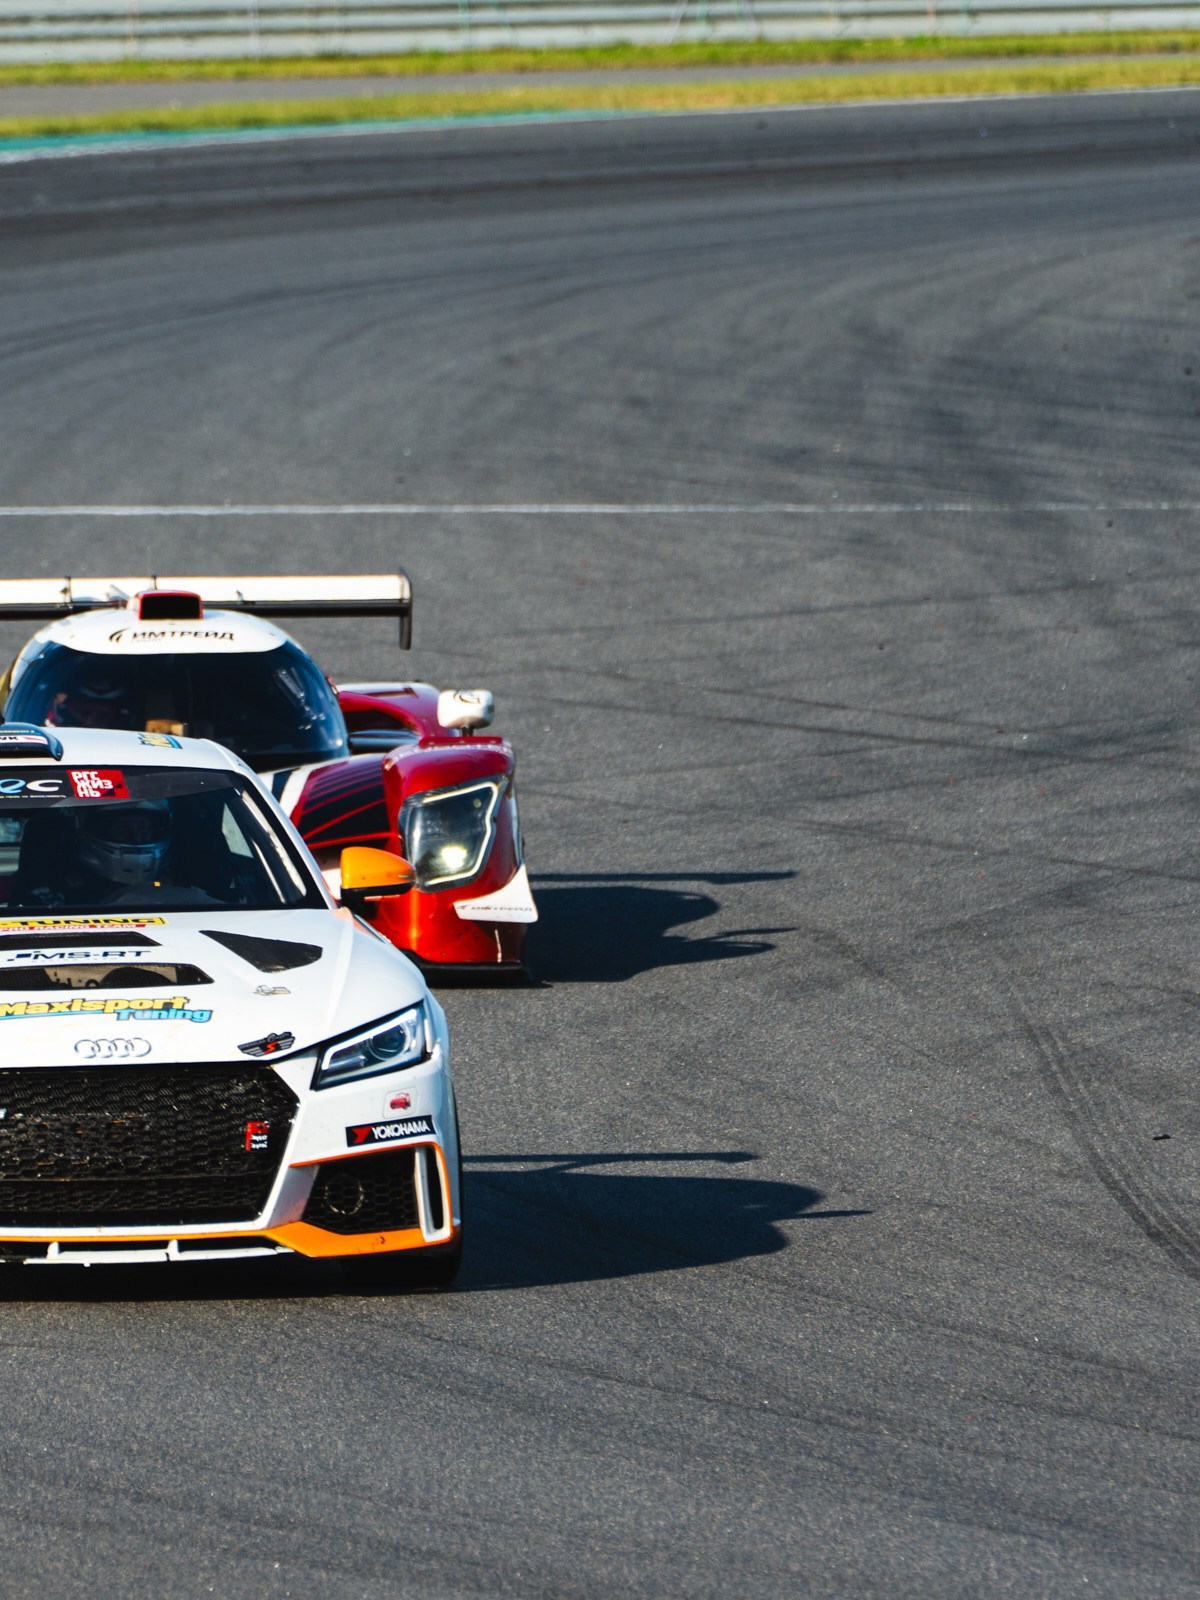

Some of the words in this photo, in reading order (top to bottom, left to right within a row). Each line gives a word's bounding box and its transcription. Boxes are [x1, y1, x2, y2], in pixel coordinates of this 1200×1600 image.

[71, 771, 99, 781] РГС
[116, 1008, 214, 1024] Tuning
[371, 1119, 431, 1140] YOKOHAMA
